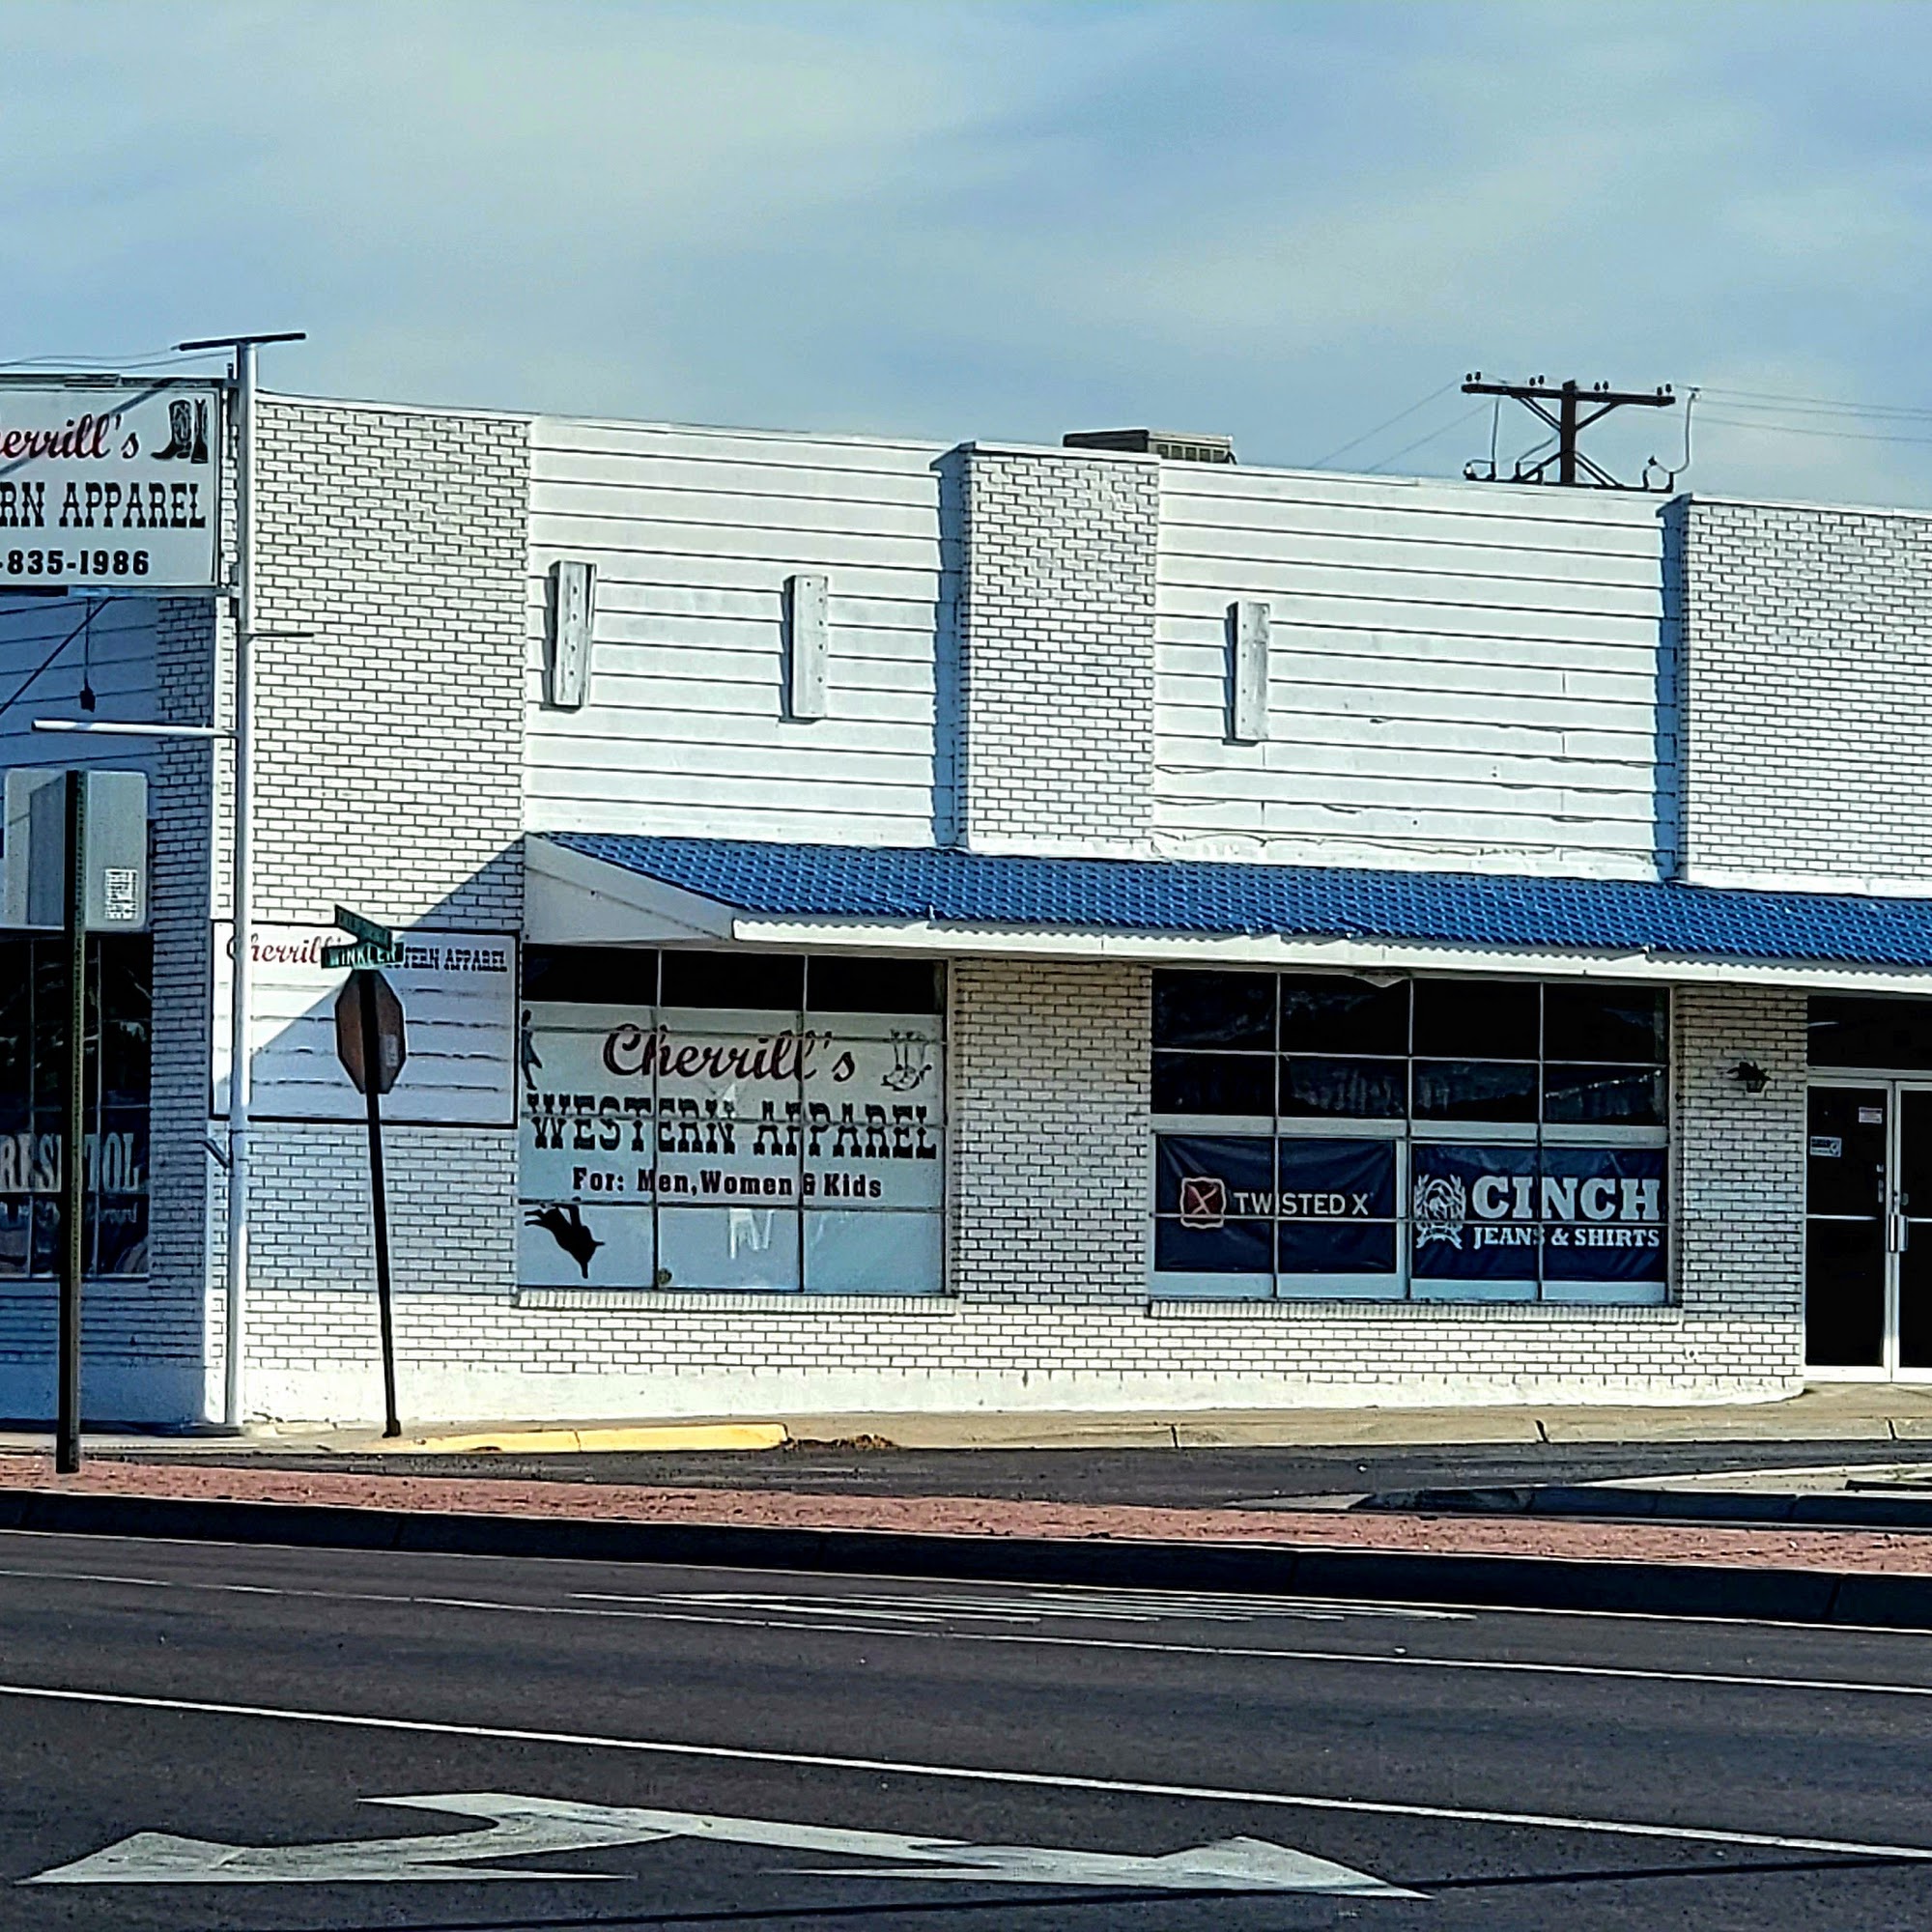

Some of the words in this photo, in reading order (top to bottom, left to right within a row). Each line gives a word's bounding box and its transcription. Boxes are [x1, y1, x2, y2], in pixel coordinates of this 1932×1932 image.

[0, 412, 139, 459] errill's
[58, 482, 207, 528] APPAREL
[602, 1023, 856, 1083] Cherrill's
[526, 1093, 736, 1155] WESTERN
[753, 1099, 937, 1160] APPAREL
[572, 1167, 625, 1196] For:
[823, 1172, 883, 1199] Kids
[1234, 1191, 1346, 1215] TWSTED
[1351, 1193, 1369, 1215] X
[1471, 1175, 1661, 1221] CINCH
[1550, 1227, 1569, 1247] &
[1574, 1227, 1661, 1248] SHIRTS
